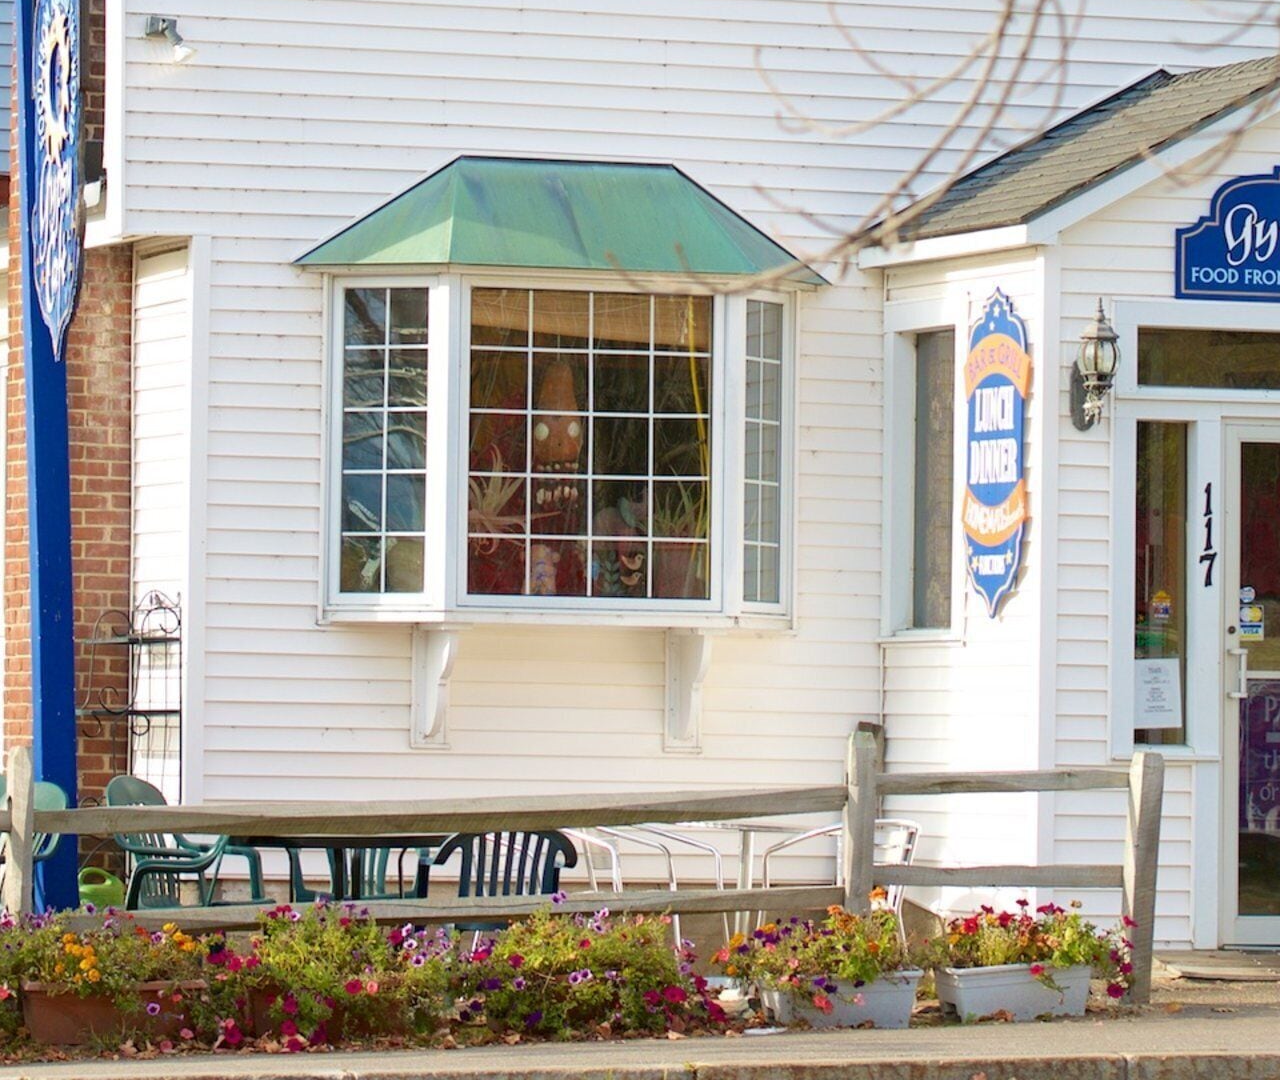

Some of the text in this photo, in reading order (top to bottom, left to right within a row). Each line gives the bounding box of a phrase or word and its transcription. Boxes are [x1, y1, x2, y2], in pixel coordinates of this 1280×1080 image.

[1191, 266, 1238, 285] FOOD
[974, 385, 1015, 433] LUNCH
[969, 437, 1018, 485] DINNER
[1198, 481, 1218, 588] 117
[1259, 785, 1279, 802] or
